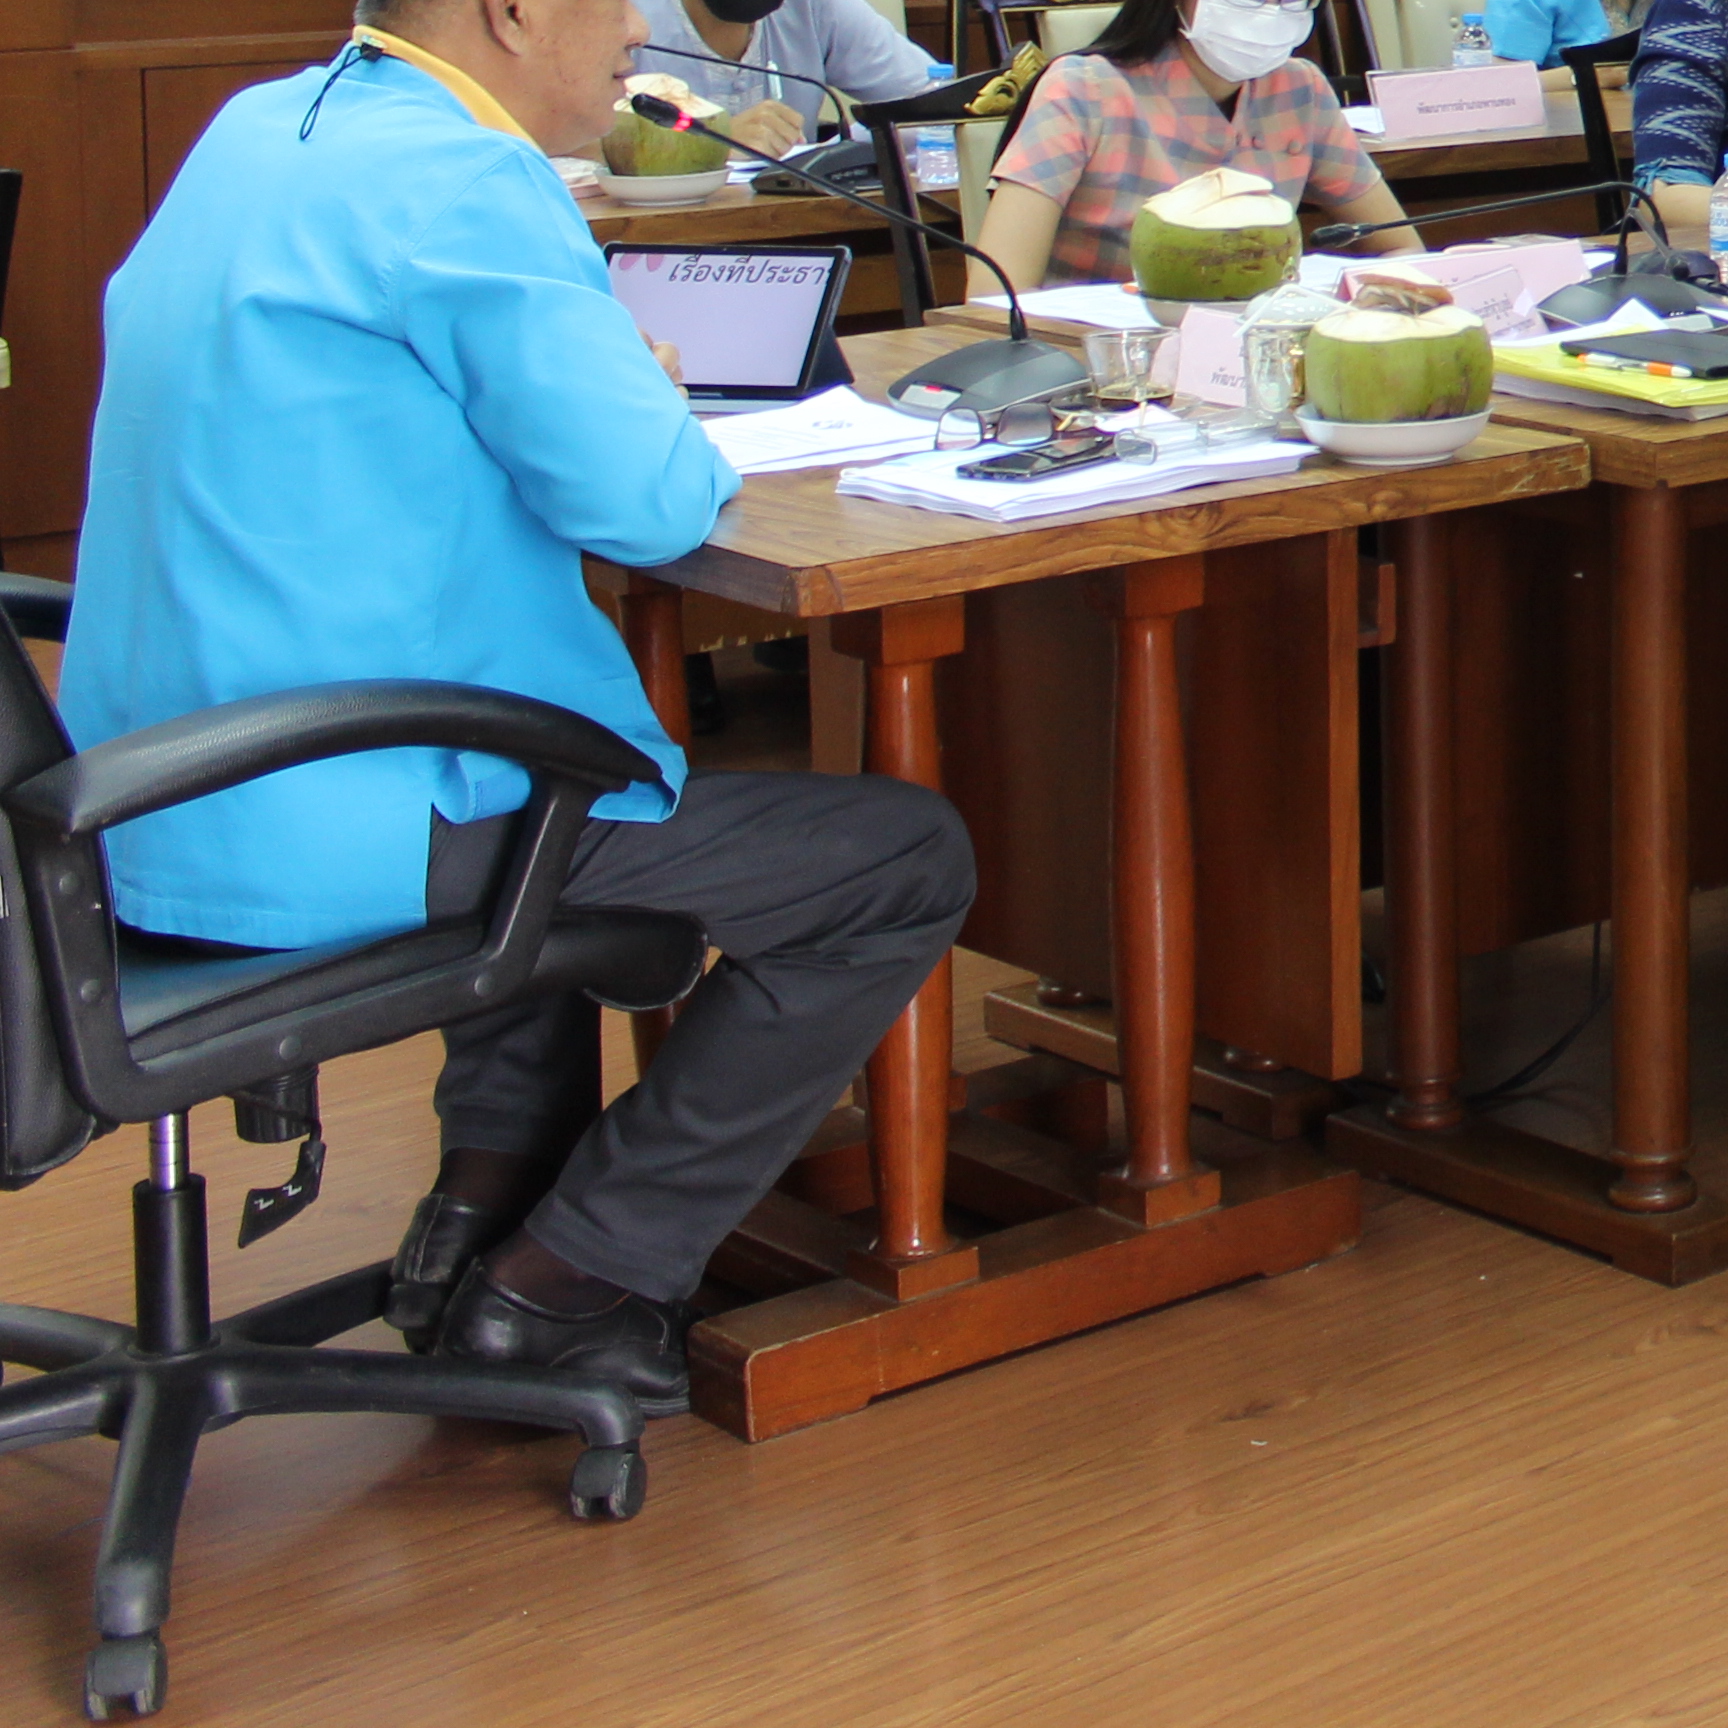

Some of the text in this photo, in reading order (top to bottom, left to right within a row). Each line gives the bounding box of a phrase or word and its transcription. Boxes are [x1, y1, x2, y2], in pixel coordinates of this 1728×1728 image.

[668, 254, 826, 285] เรืองทีประธา
